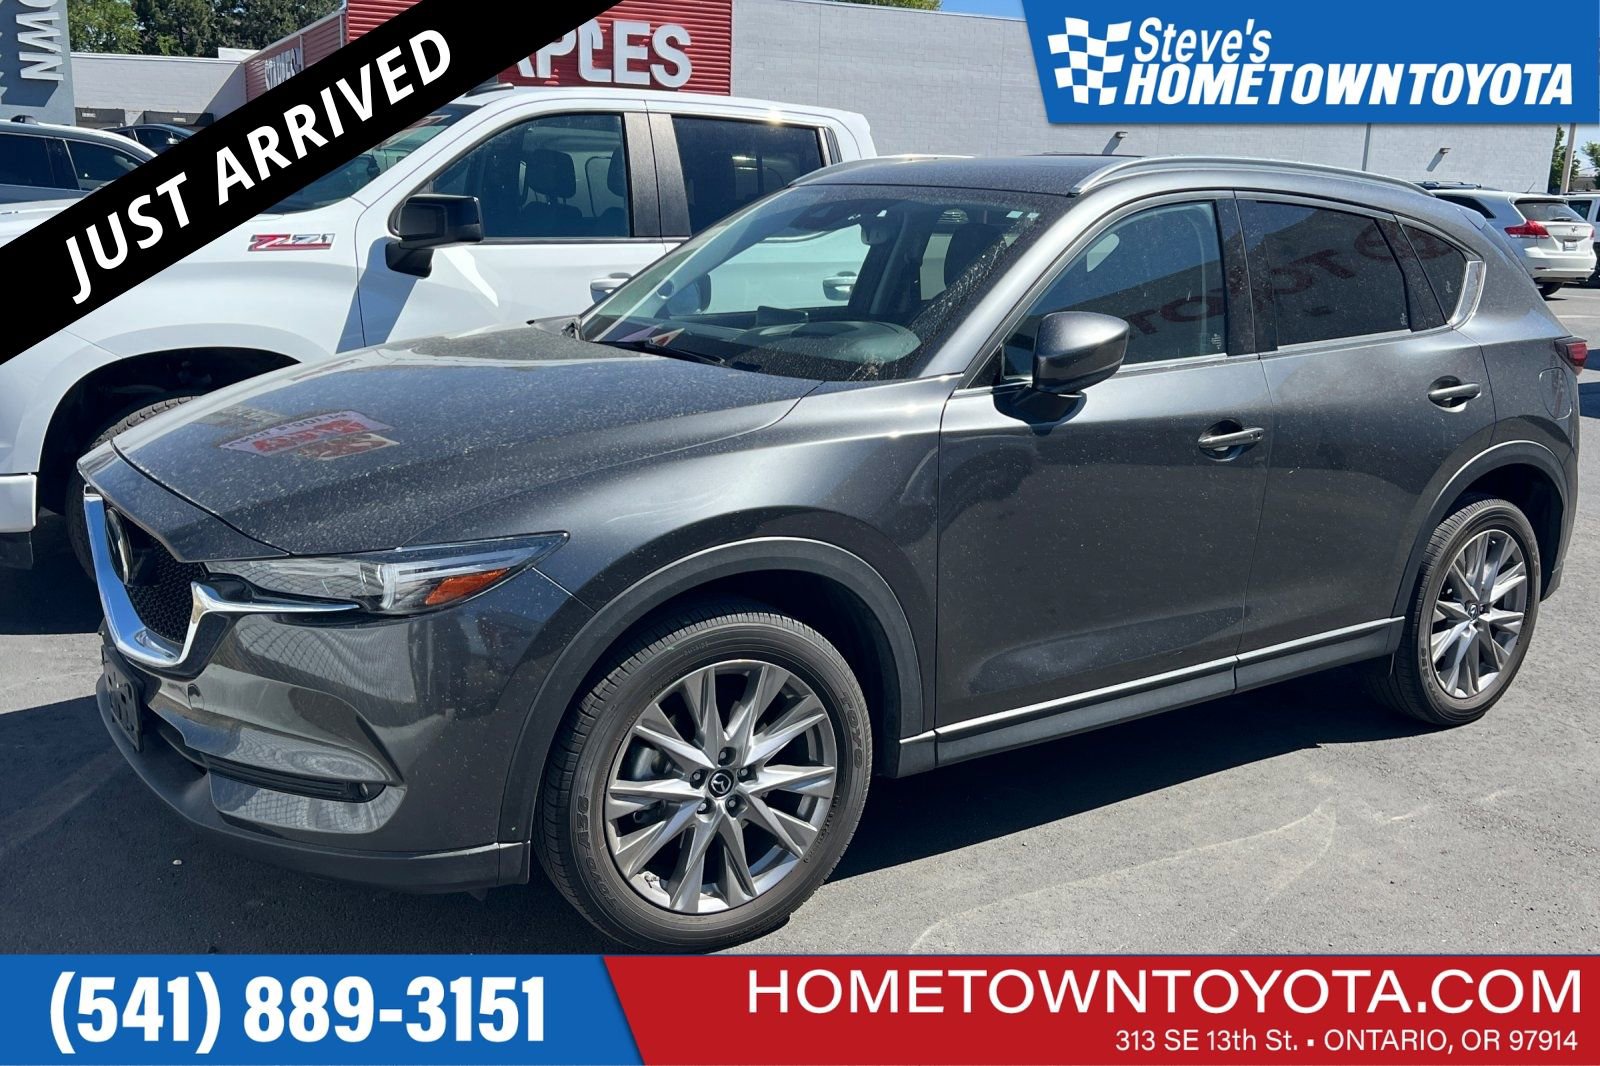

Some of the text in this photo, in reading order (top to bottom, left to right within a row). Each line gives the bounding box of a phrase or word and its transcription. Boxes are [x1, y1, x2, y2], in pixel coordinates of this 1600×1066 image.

[16, 0, 64, 80] WN
[516, 18, 693, 88] PLES
[247, 233, 335, 252] Z71
[841, 691, 863, 769] TOYO
